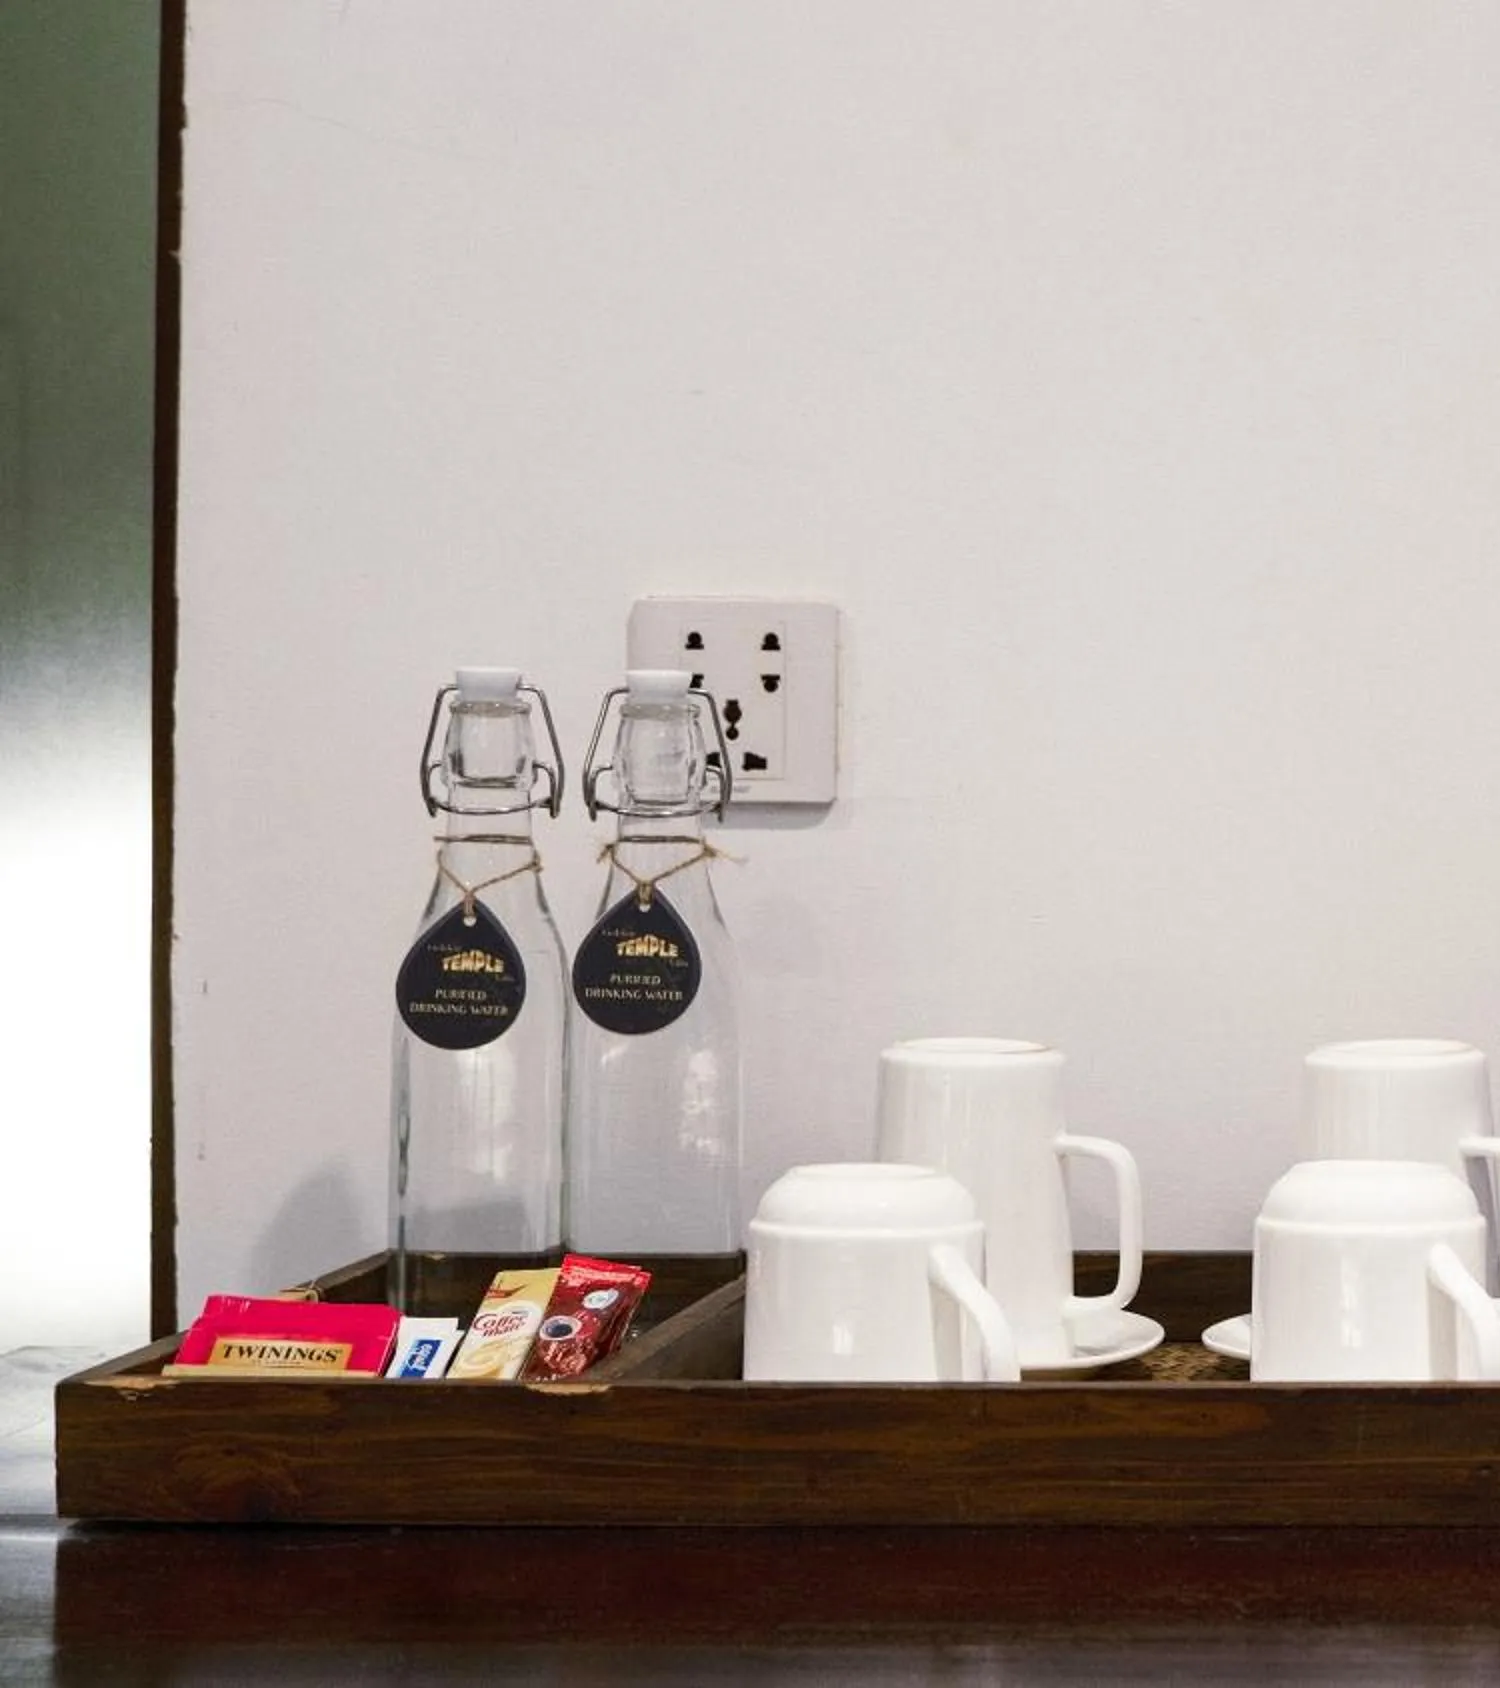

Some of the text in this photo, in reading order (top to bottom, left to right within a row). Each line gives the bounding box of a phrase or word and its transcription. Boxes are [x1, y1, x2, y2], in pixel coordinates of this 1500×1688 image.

[616, 934, 679, 957] TEMPLE
[442, 948, 504, 973] TEMPLE
[585, 987, 683, 1001] DRINKING WATER
[409, 1002, 508, 1016] DRINKING WATER
[473, 1313, 525, 1331] Coffee
[223, 1343, 338, 1363] TWININGS
